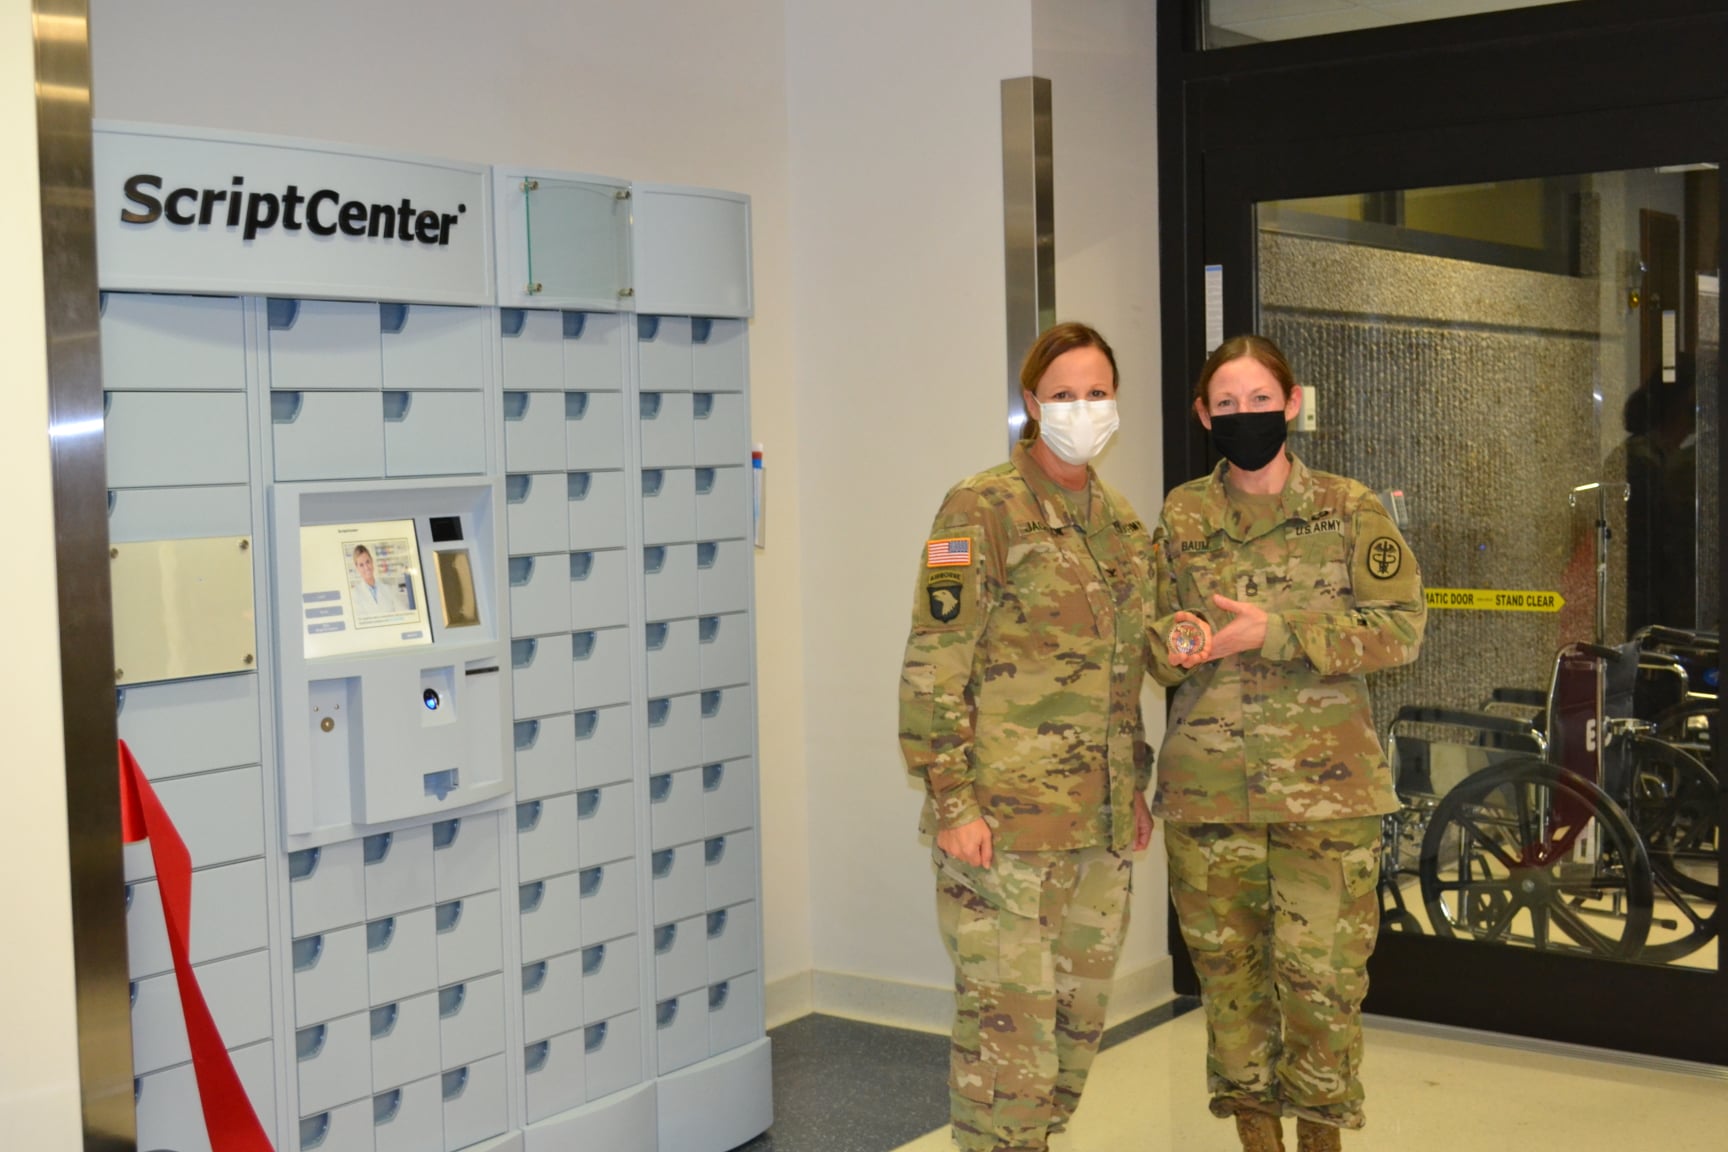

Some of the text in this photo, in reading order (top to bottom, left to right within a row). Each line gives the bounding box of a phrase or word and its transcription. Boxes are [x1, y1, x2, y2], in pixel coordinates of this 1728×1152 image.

[120, 173, 459, 246] ScriptCenter
[1313, 519, 1341, 533] ARMY
[1450, 593, 1474, 606] DOOR
[1495, 594, 1524, 607] STAND
[1526, 595, 1555, 608] CLEAR
